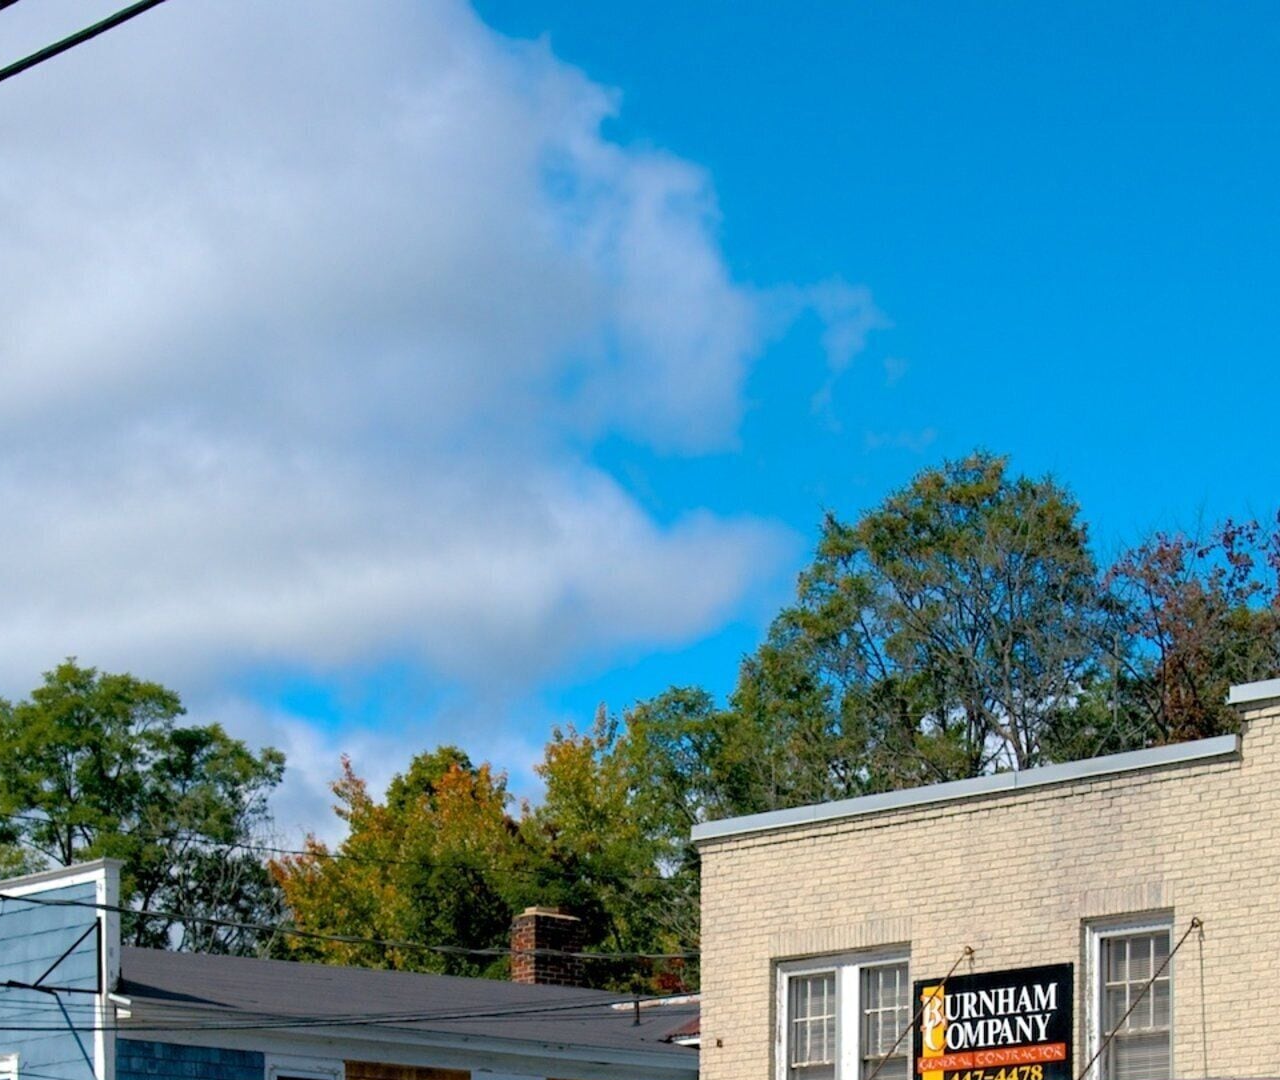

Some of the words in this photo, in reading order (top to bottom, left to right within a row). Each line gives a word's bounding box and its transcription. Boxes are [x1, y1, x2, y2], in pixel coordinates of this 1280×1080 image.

[921, 982, 1058, 1028] BURNHAM
[923, 1013, 1052, 1051] COMPANY
[919, 1055, 973, 1071] GENERAL
[975, 1046, 1063, 1065] CONTRACTOR
